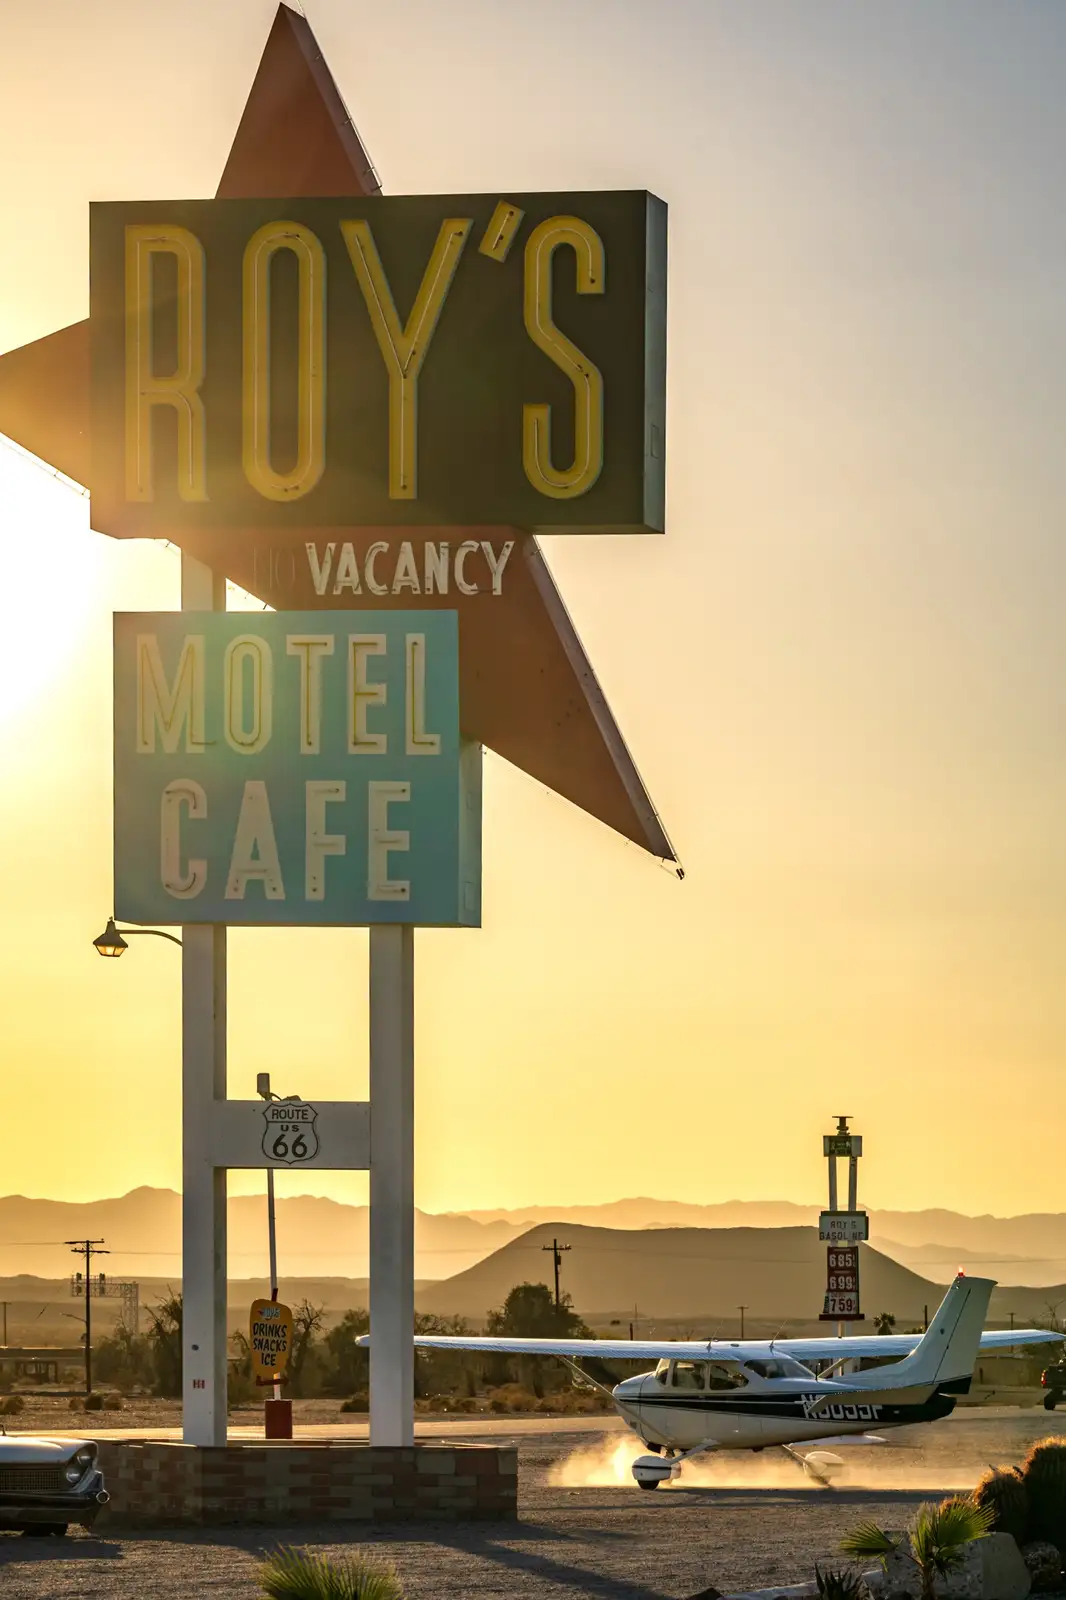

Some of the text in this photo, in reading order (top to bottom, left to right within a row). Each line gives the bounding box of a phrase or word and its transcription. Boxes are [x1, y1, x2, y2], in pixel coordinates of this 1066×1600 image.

[125, 200, 606, 503] ROY'S
[305, 540, 515, 596] VACANCY
[136, 633, 441, 755] MOTEL
[160, 779, 411, 901] CAFE
[271, 1108, 309, 1120] ROUTE
[272, 1133, 308, 1158] 66
[829, 1253, 853, 1268] 685
[830, 1297, 853, 1313] 759
[252, 1322, 288, 1338] DRINKS
[252, 1337, 288, 1353] SNACKS
[261, 1353, 277, 1367] ICE
